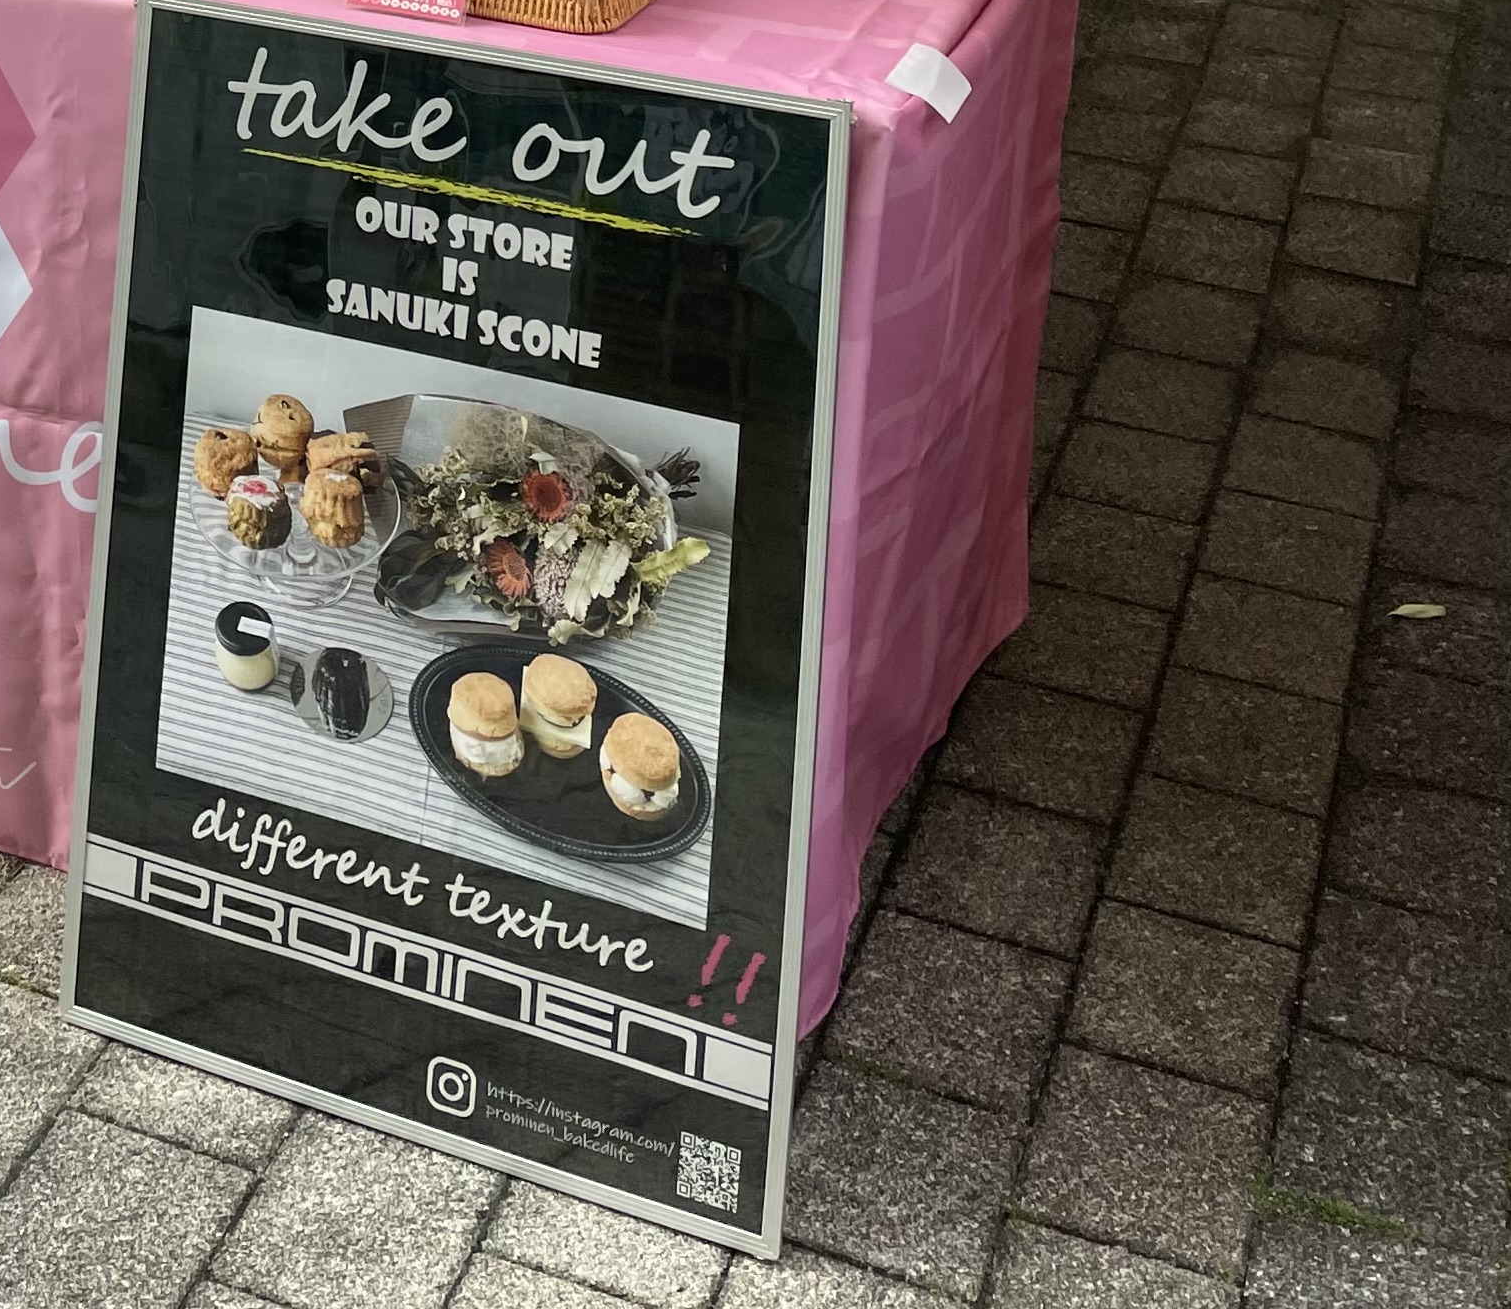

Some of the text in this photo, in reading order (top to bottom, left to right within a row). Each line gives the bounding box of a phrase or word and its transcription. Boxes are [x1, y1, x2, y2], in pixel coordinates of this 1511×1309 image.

[227, 46, 735, 219] take out
[355, 195, 574, 272] OUR STORE
[442, 256, 479, 296] IS
[325, 278, 603, 369] SANUKI SCONE
[191, 798, 430, 907] different
[444, 872, 655, 975] texture
[139, 864, 701, 1078] PROMINEN
[485, 1104, 636, 1164] prominen_bakedlife
[486, 1081, 676, 1158] https://instagram.com/
